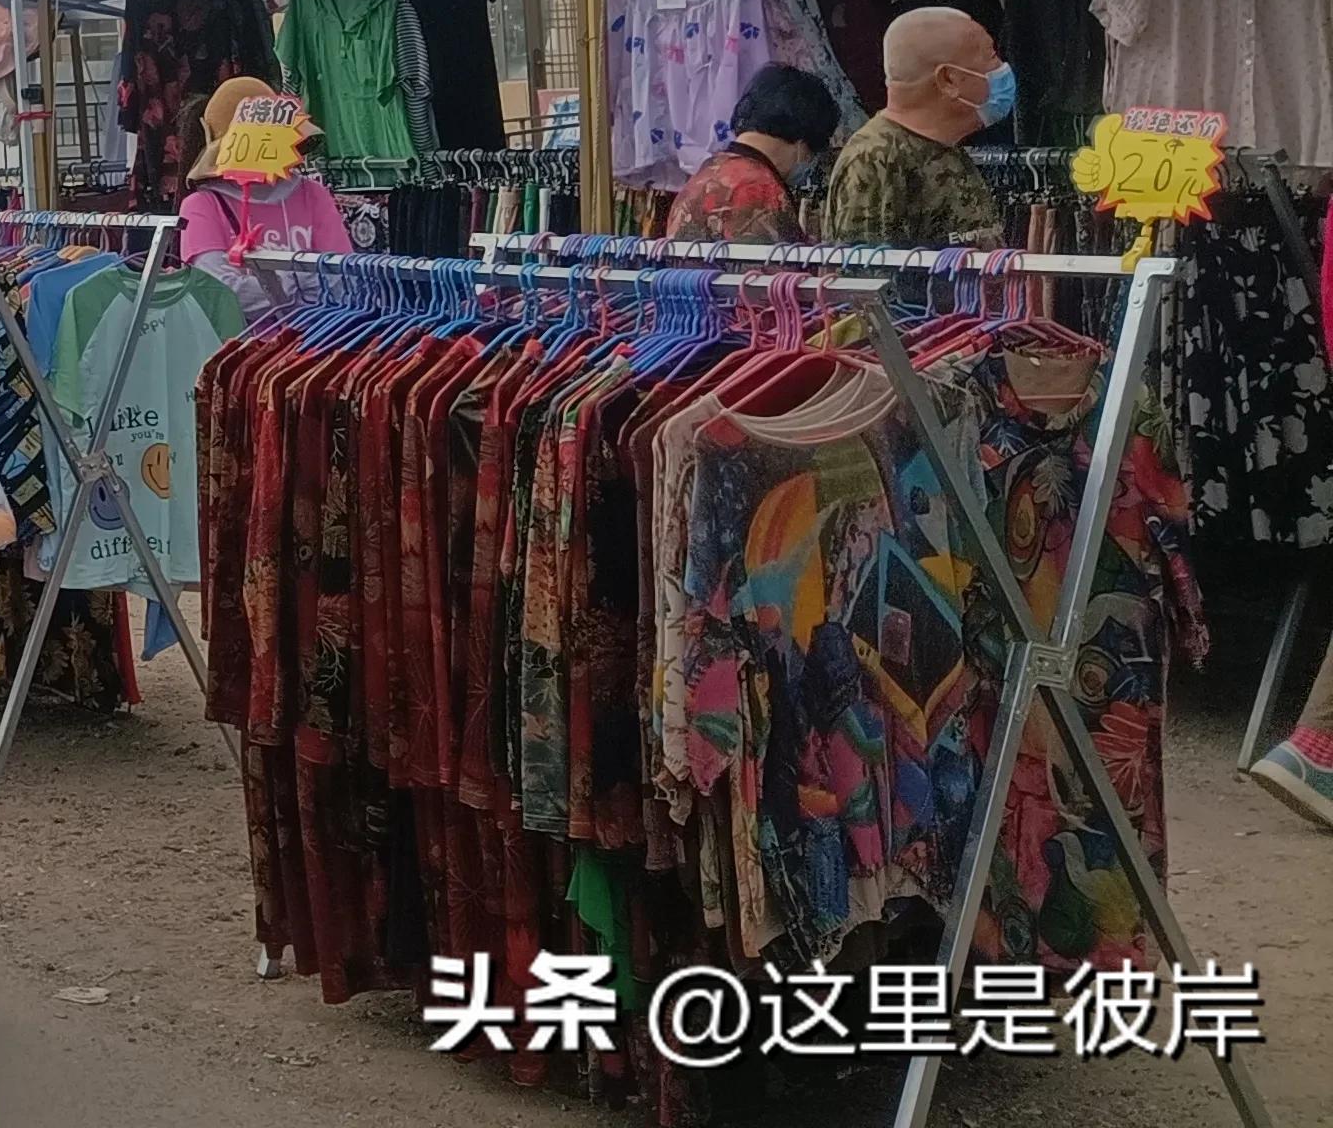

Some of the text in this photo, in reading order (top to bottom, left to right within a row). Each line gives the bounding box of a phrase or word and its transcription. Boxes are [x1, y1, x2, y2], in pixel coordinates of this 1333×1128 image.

[1123, 108, 1222, 138] 谢绝还价
[1117, 152, 1205, 205] 20元
